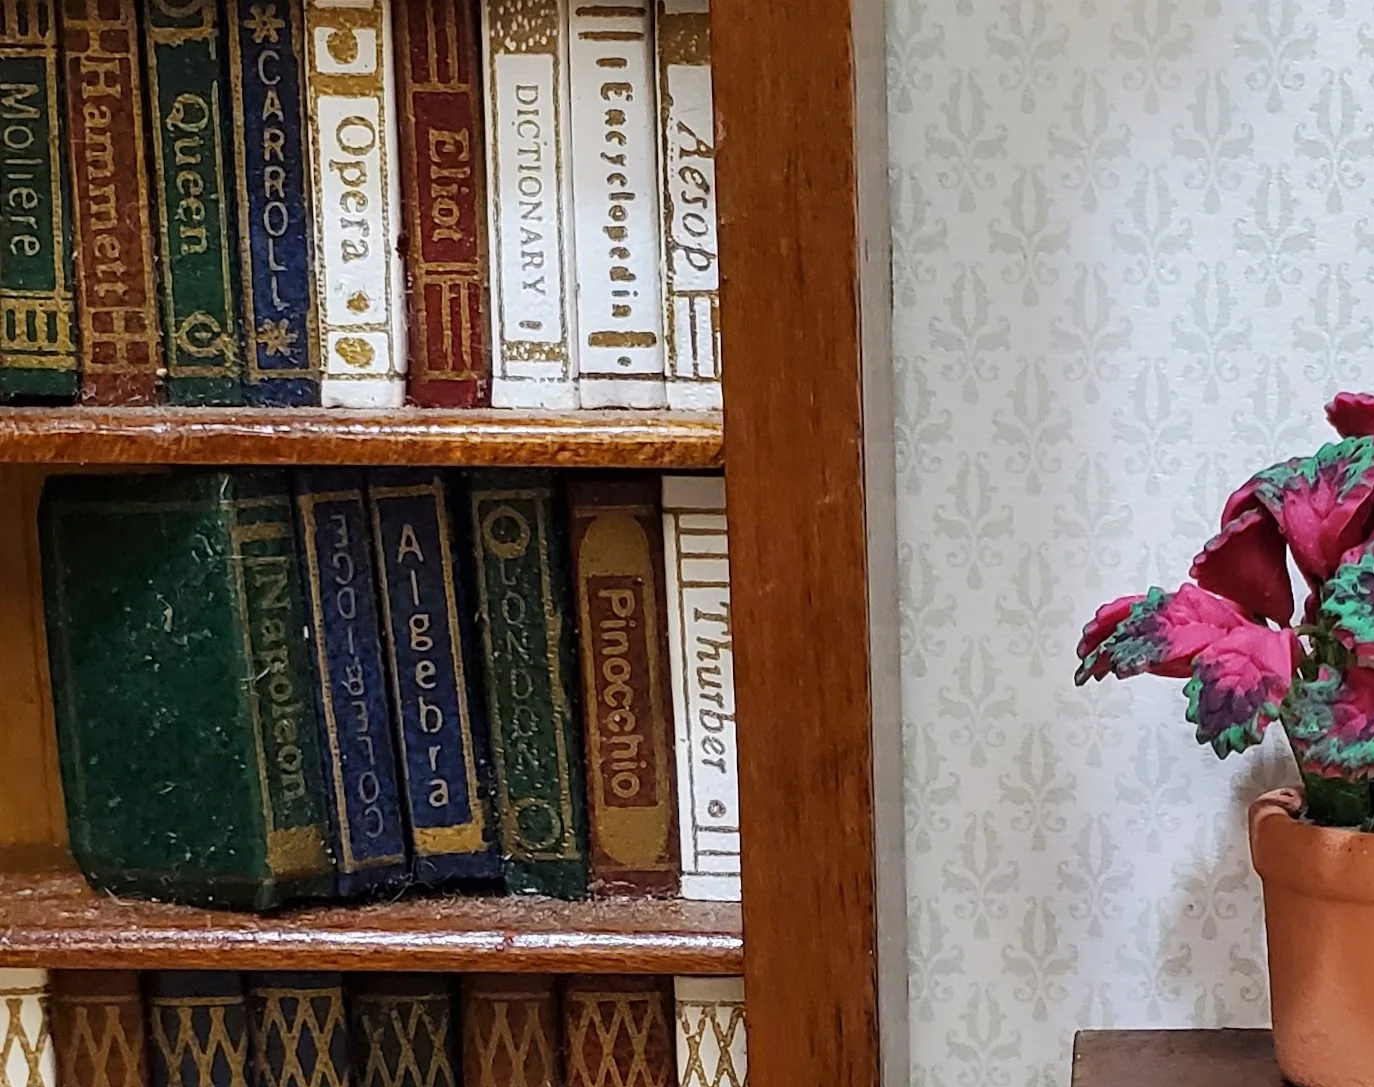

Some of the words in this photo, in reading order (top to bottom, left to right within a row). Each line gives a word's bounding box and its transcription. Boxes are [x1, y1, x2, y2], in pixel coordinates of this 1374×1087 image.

[79, 56, 130, 302] Hammett
[166, 93, 210, 256] Queen
[257, 49, 291, 312] CARROLL
[328, 115, 377, 265] Opera
[428, 127, 470, 243] Eliot
[513, 83, 548, 297] DICTIONARY
[600, 82, 637, 318] Encyclopedia
[673, 120, 717, 272] Aesop
[254, 572, 307, 803] Napoleon
[326, 514, 385, 839] COLERIDGE
[398, 524, 451, 808] Algebra
[501, 555, 539, 776] LONDON
[597, 588, 646, 800] Pinocchio
[692, 601, 735, 776] Thurber
